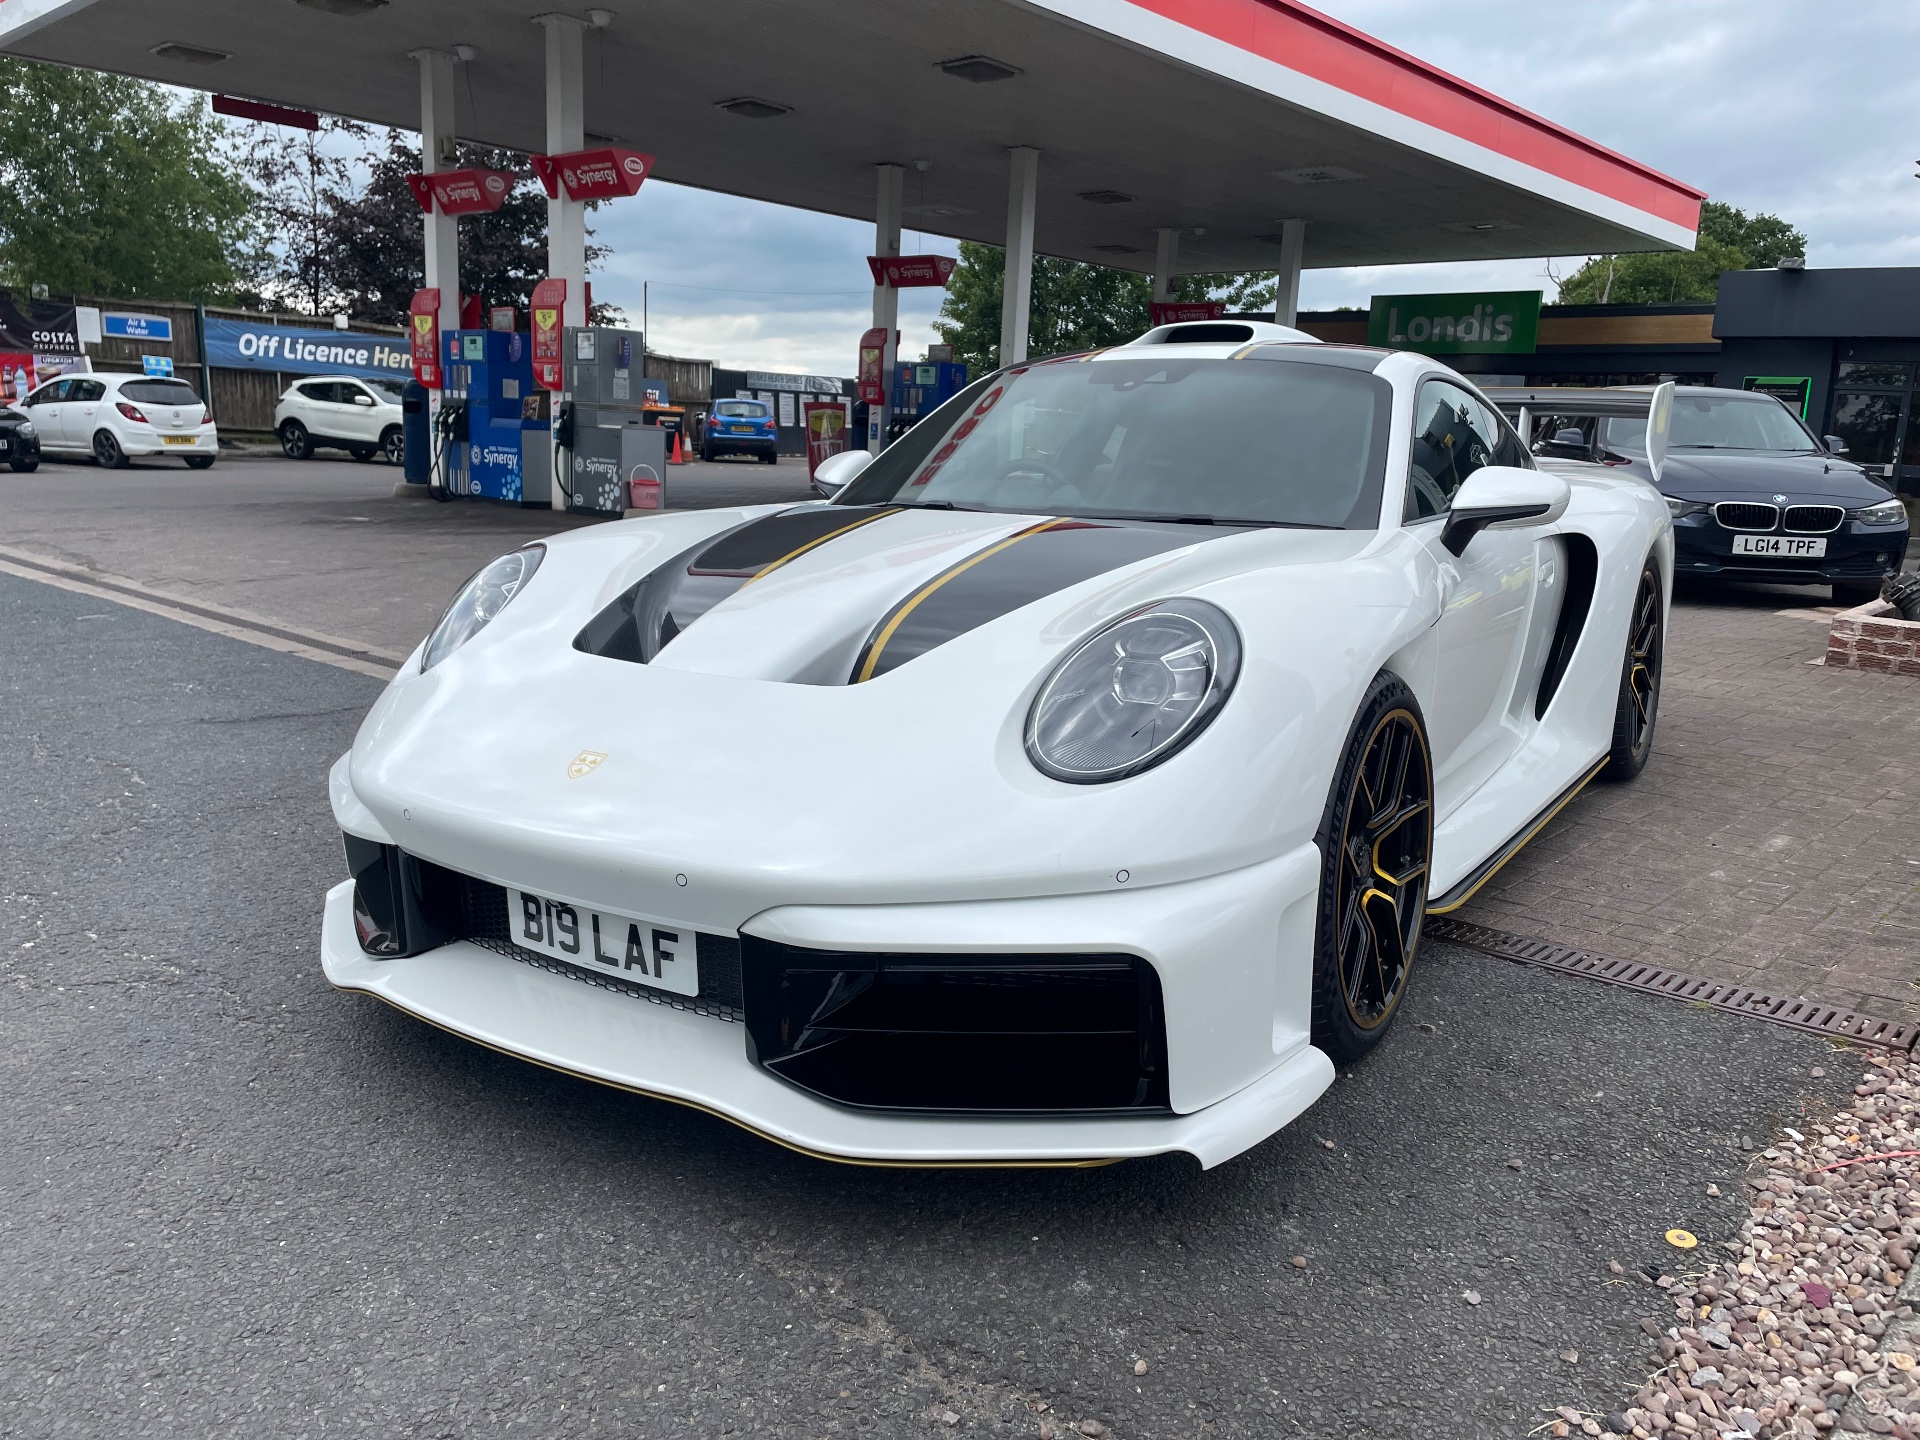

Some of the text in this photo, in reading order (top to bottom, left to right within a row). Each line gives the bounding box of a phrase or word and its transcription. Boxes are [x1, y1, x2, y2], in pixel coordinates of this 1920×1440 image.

[545, 161, 553, 174] 7
[576, 168, 618, 187] Synergy
[420, 180, 428, 192] 6
[446, 187, 481, 204] Synergy
[900, 267, 933, 279] Synergy
[127, 317, 147, 327] Air &
[1177, 311, 1208, 320] Synergy
[1387, 304, 1513, 342] Londis
[32, 331, 74, 344] COSTA
[126, 326, 149, 336] Water
[238, 332, 280, 357] Off
[283, 337, 369, 366] Licence
[646, 389, 660, 400] Off
[483, 448, 518, 469] Synergy
[586, 459, 617, 475] Synergy
[1743, 538, 1817, 554] LG14 TPF
[1324, 801, 1343, 915] MICHELIN
[520, 891, 679, 979] B19 LAF
